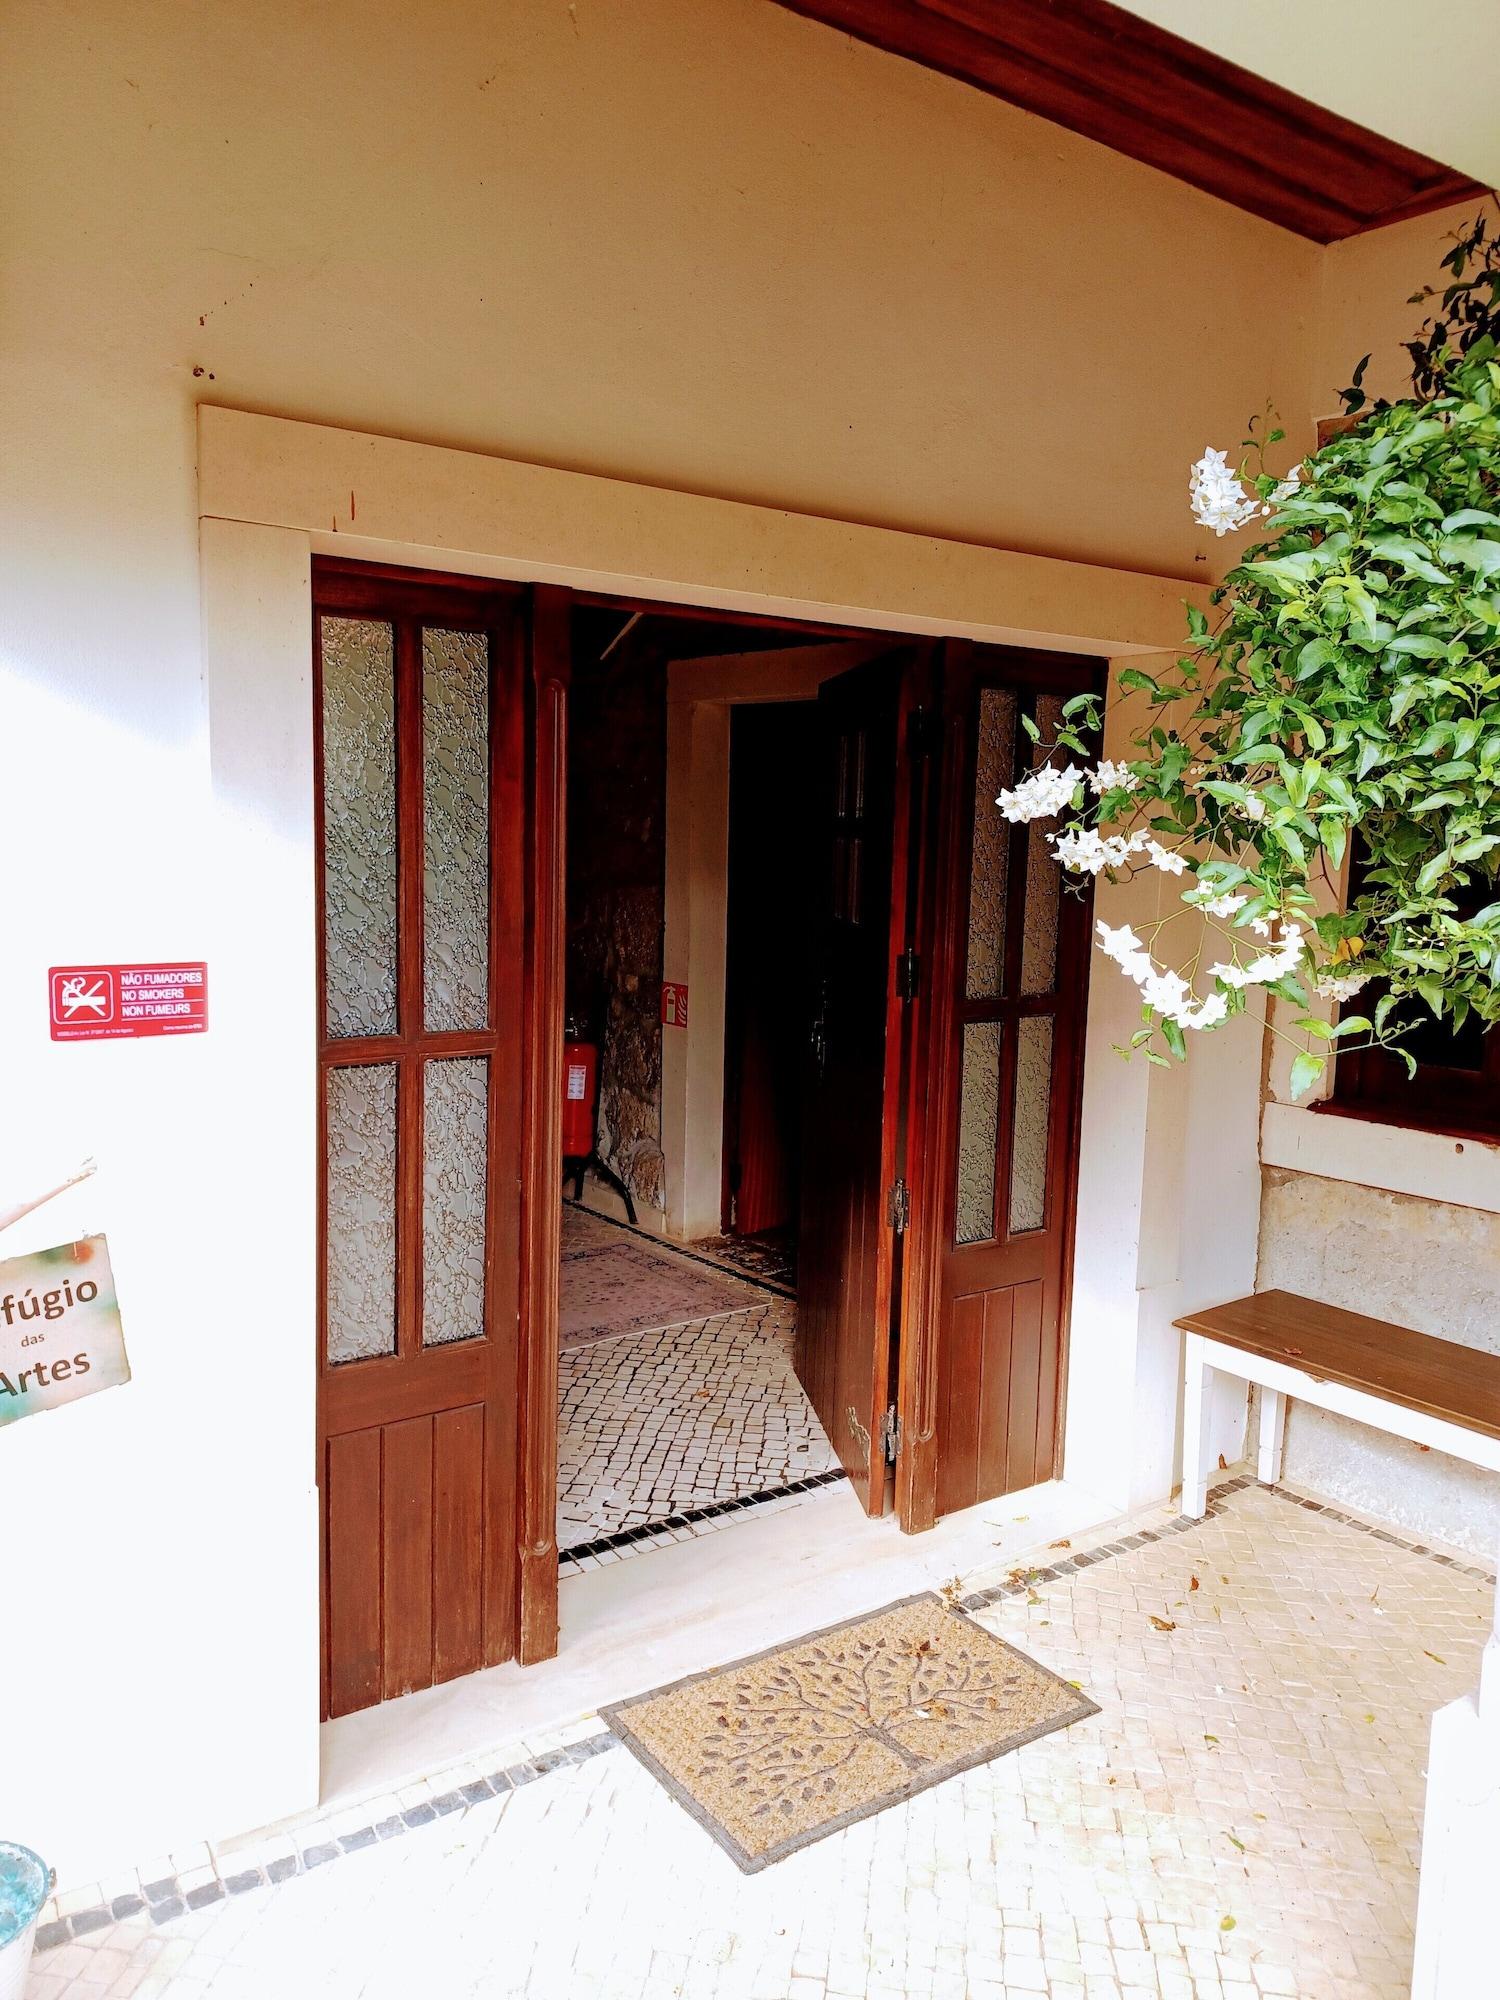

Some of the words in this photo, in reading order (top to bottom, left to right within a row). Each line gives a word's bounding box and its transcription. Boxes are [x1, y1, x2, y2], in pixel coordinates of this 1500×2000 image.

[121, 973, 143, 986] NÃO
[144, 972, 203, 985] FUMADORES
[121, 989, 137, 1001] NO
[139, 988, 185, 1000] SMOKERS
[122, 1005, 144, 1017] NON
[145, 1003, 191, 1016] FUMEURS
[0, 1279, 98, 1326] fúgio
[21, 1333, 45, 1348] das
[0, 1352, 91, 1397] Artes
